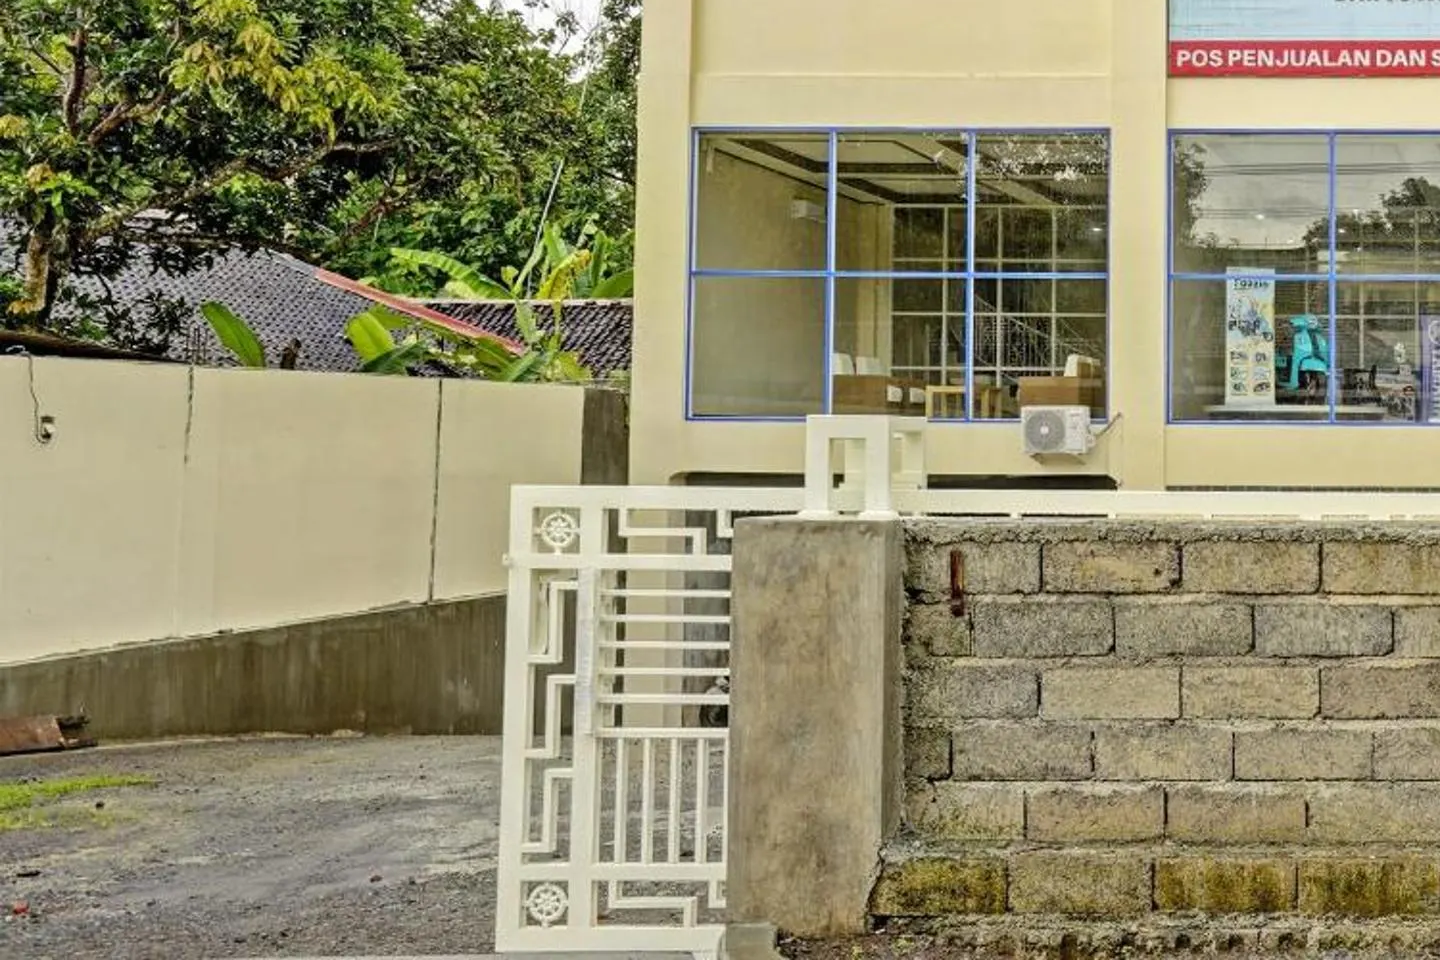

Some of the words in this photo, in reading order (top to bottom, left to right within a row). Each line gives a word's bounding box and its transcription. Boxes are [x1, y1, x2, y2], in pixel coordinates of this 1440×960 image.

[1176, 48, 1224, 68] POS
[1228, 48, 1371, 68] PENJUALAN
[1376, 48, 1427, 68] DAN
